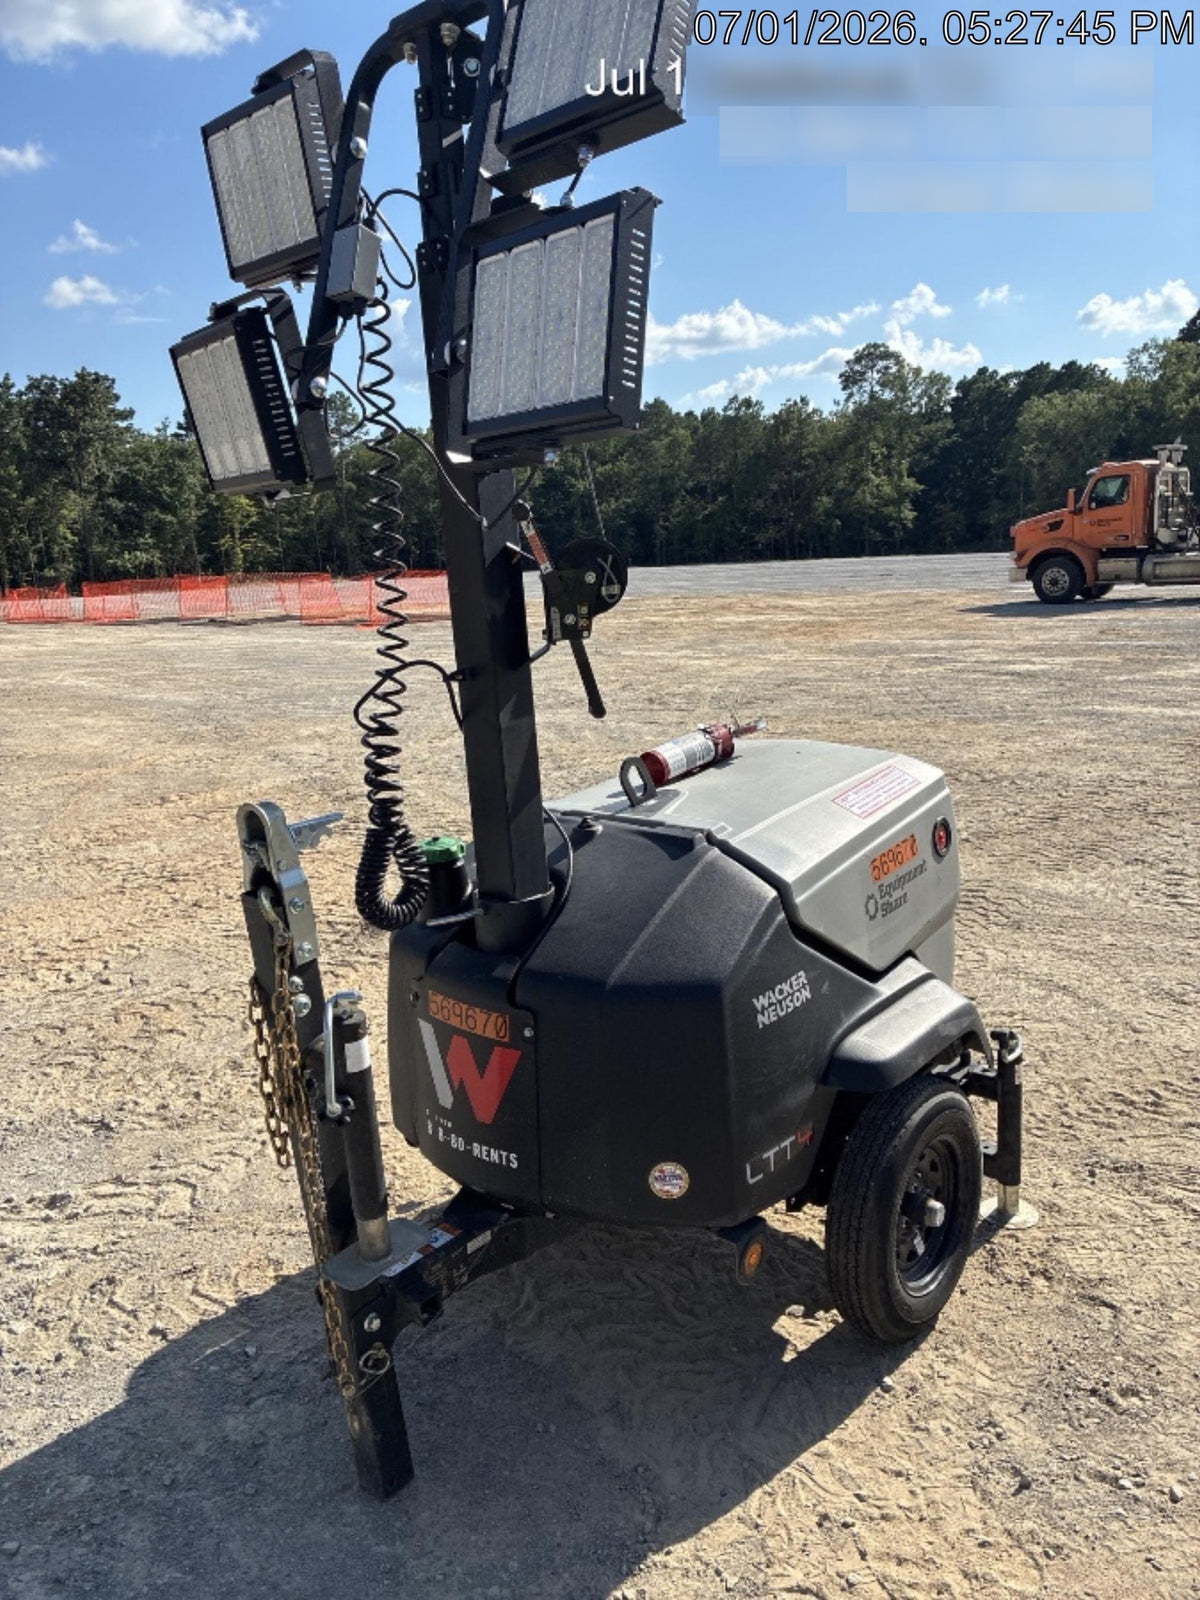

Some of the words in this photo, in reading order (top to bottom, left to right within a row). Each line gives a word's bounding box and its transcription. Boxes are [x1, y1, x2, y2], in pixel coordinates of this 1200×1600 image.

[878, 858, 927, 900] Equipment
[880, 892, 908, 918] Share
[752, 970, 808, 1012] WACKER
[757, 985, 811, 1030] NEUSON
[429, 989, 508, 1040] 569670
